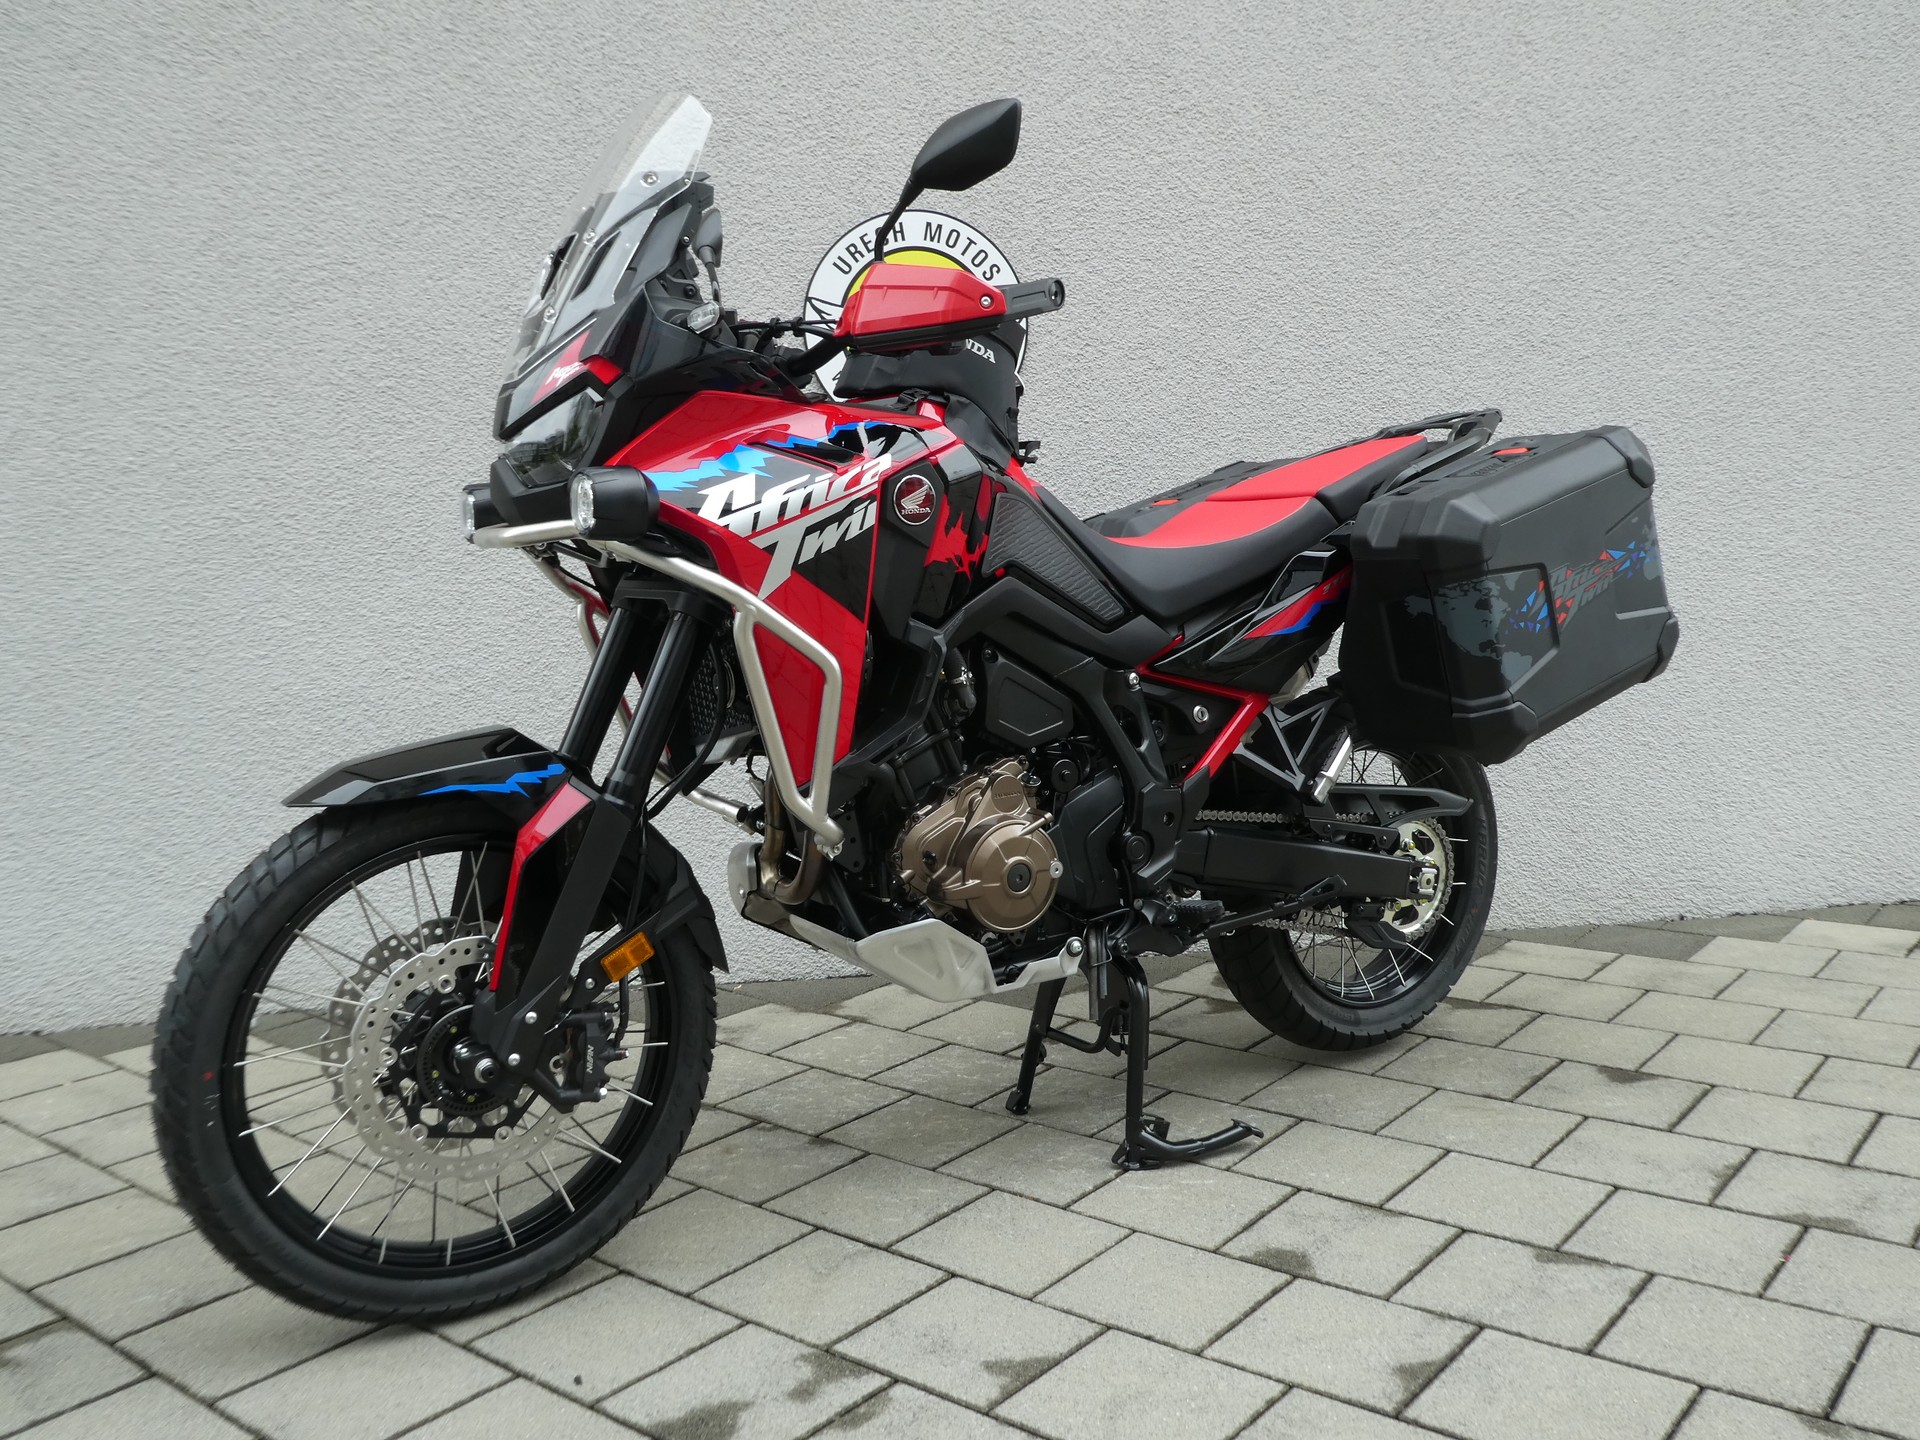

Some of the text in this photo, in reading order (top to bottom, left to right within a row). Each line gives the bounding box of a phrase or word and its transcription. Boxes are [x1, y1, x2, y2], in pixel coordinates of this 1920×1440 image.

[923, 221, 1002, 282] MOTOS
[965, 338, 996, 364] NDA
[697, 453, 892, 537] Africa
[901, 507, 932, 515] HONDA
